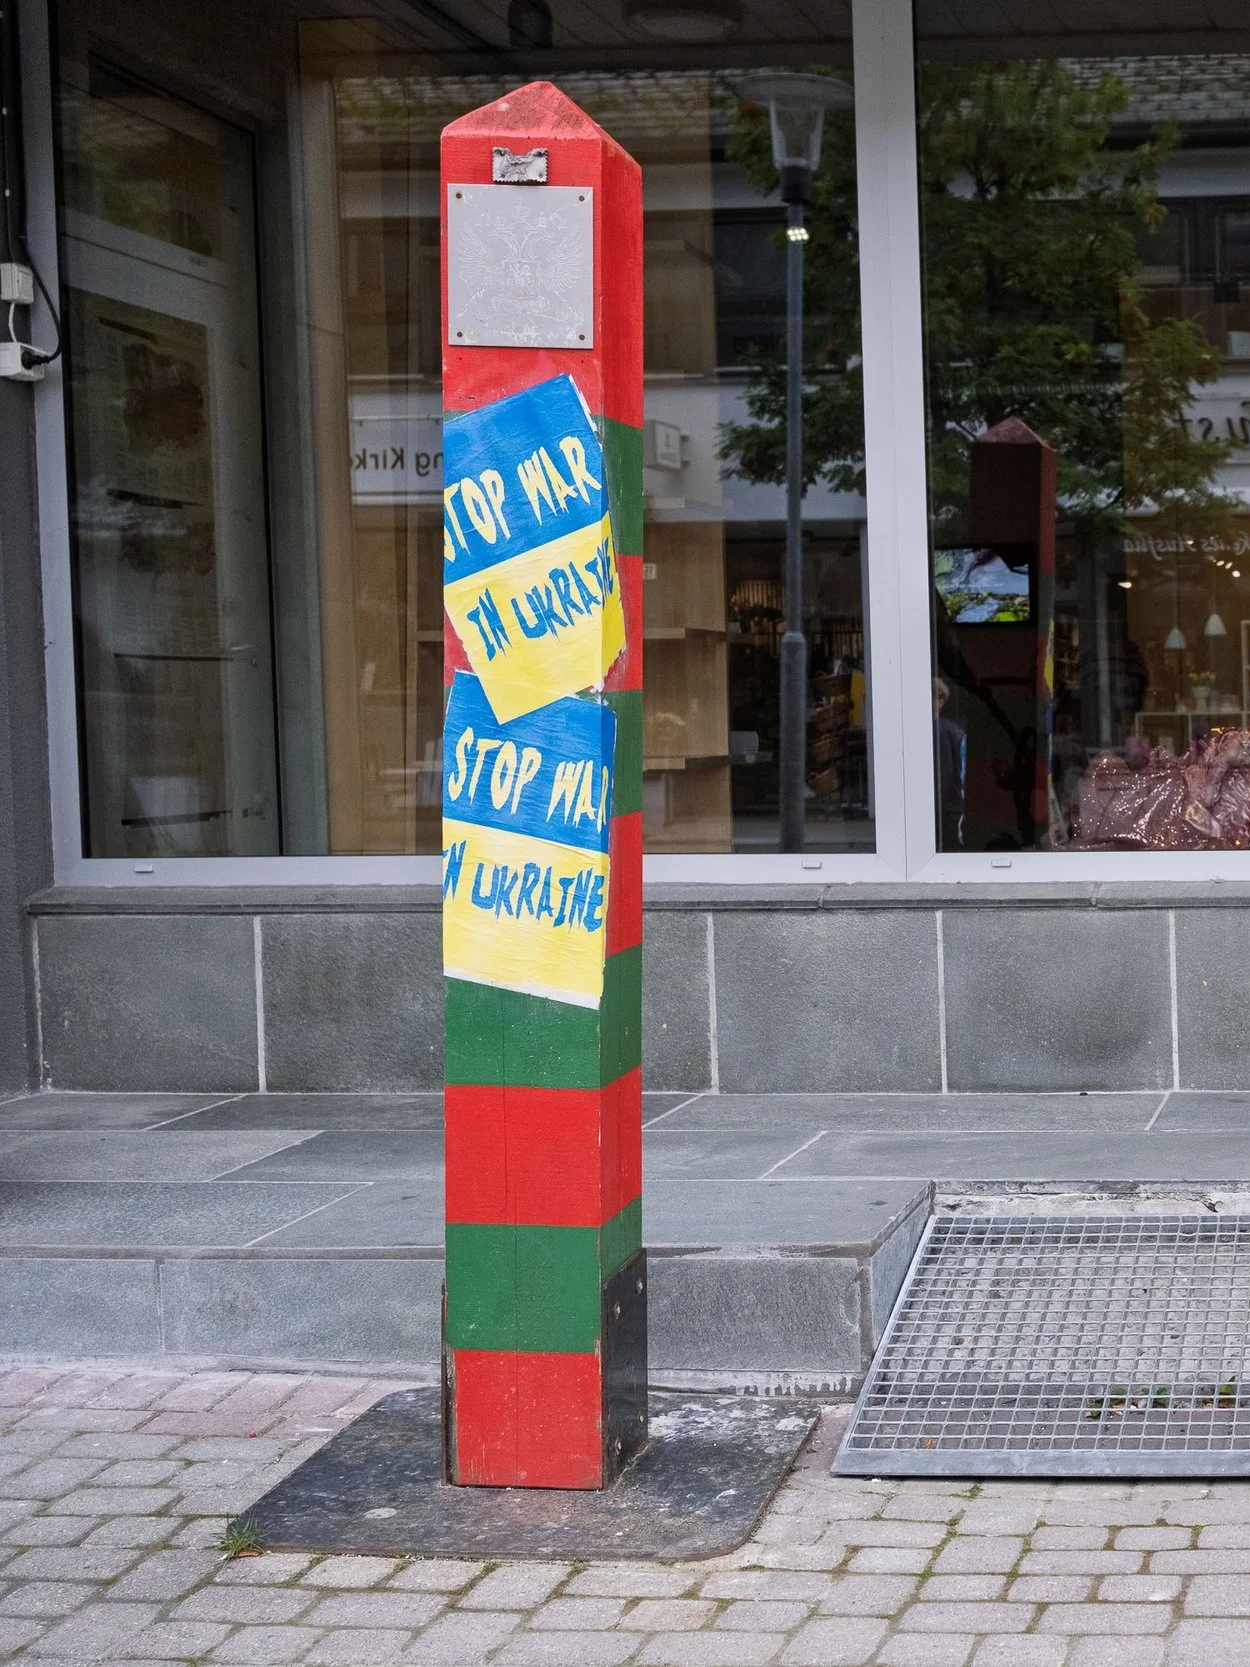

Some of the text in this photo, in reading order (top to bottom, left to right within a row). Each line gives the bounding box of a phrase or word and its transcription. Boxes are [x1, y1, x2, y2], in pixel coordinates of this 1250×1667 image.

[517, 436, 602, 527] WAR
[466, 537, 614, 662] IN UKRAINE
[448, 727, 609, 834] STOP WAR
[471, 862, 605, 933] UKRAINE
